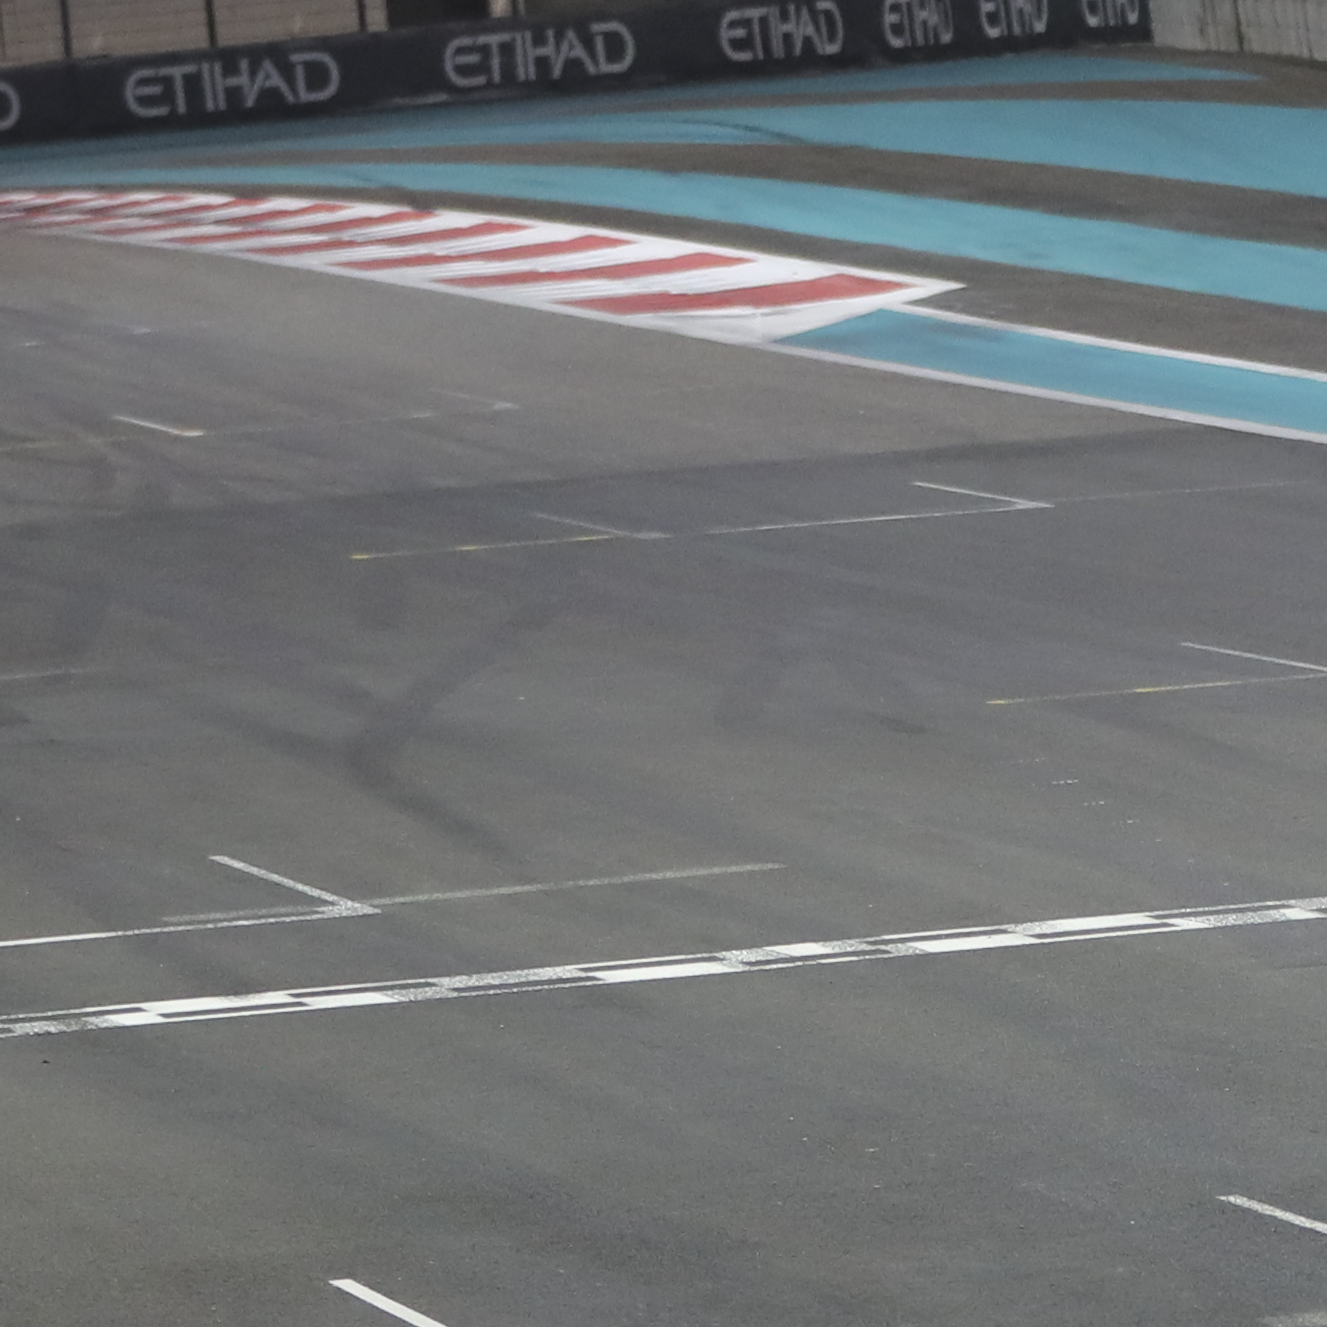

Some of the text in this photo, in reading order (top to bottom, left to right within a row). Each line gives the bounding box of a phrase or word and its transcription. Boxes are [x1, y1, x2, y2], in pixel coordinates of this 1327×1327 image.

[445, 21, 635, 88] ETIHAD
[720, 1, 844, 62] ETIHAD
[125, 51, 341, 118] ETIHAD
